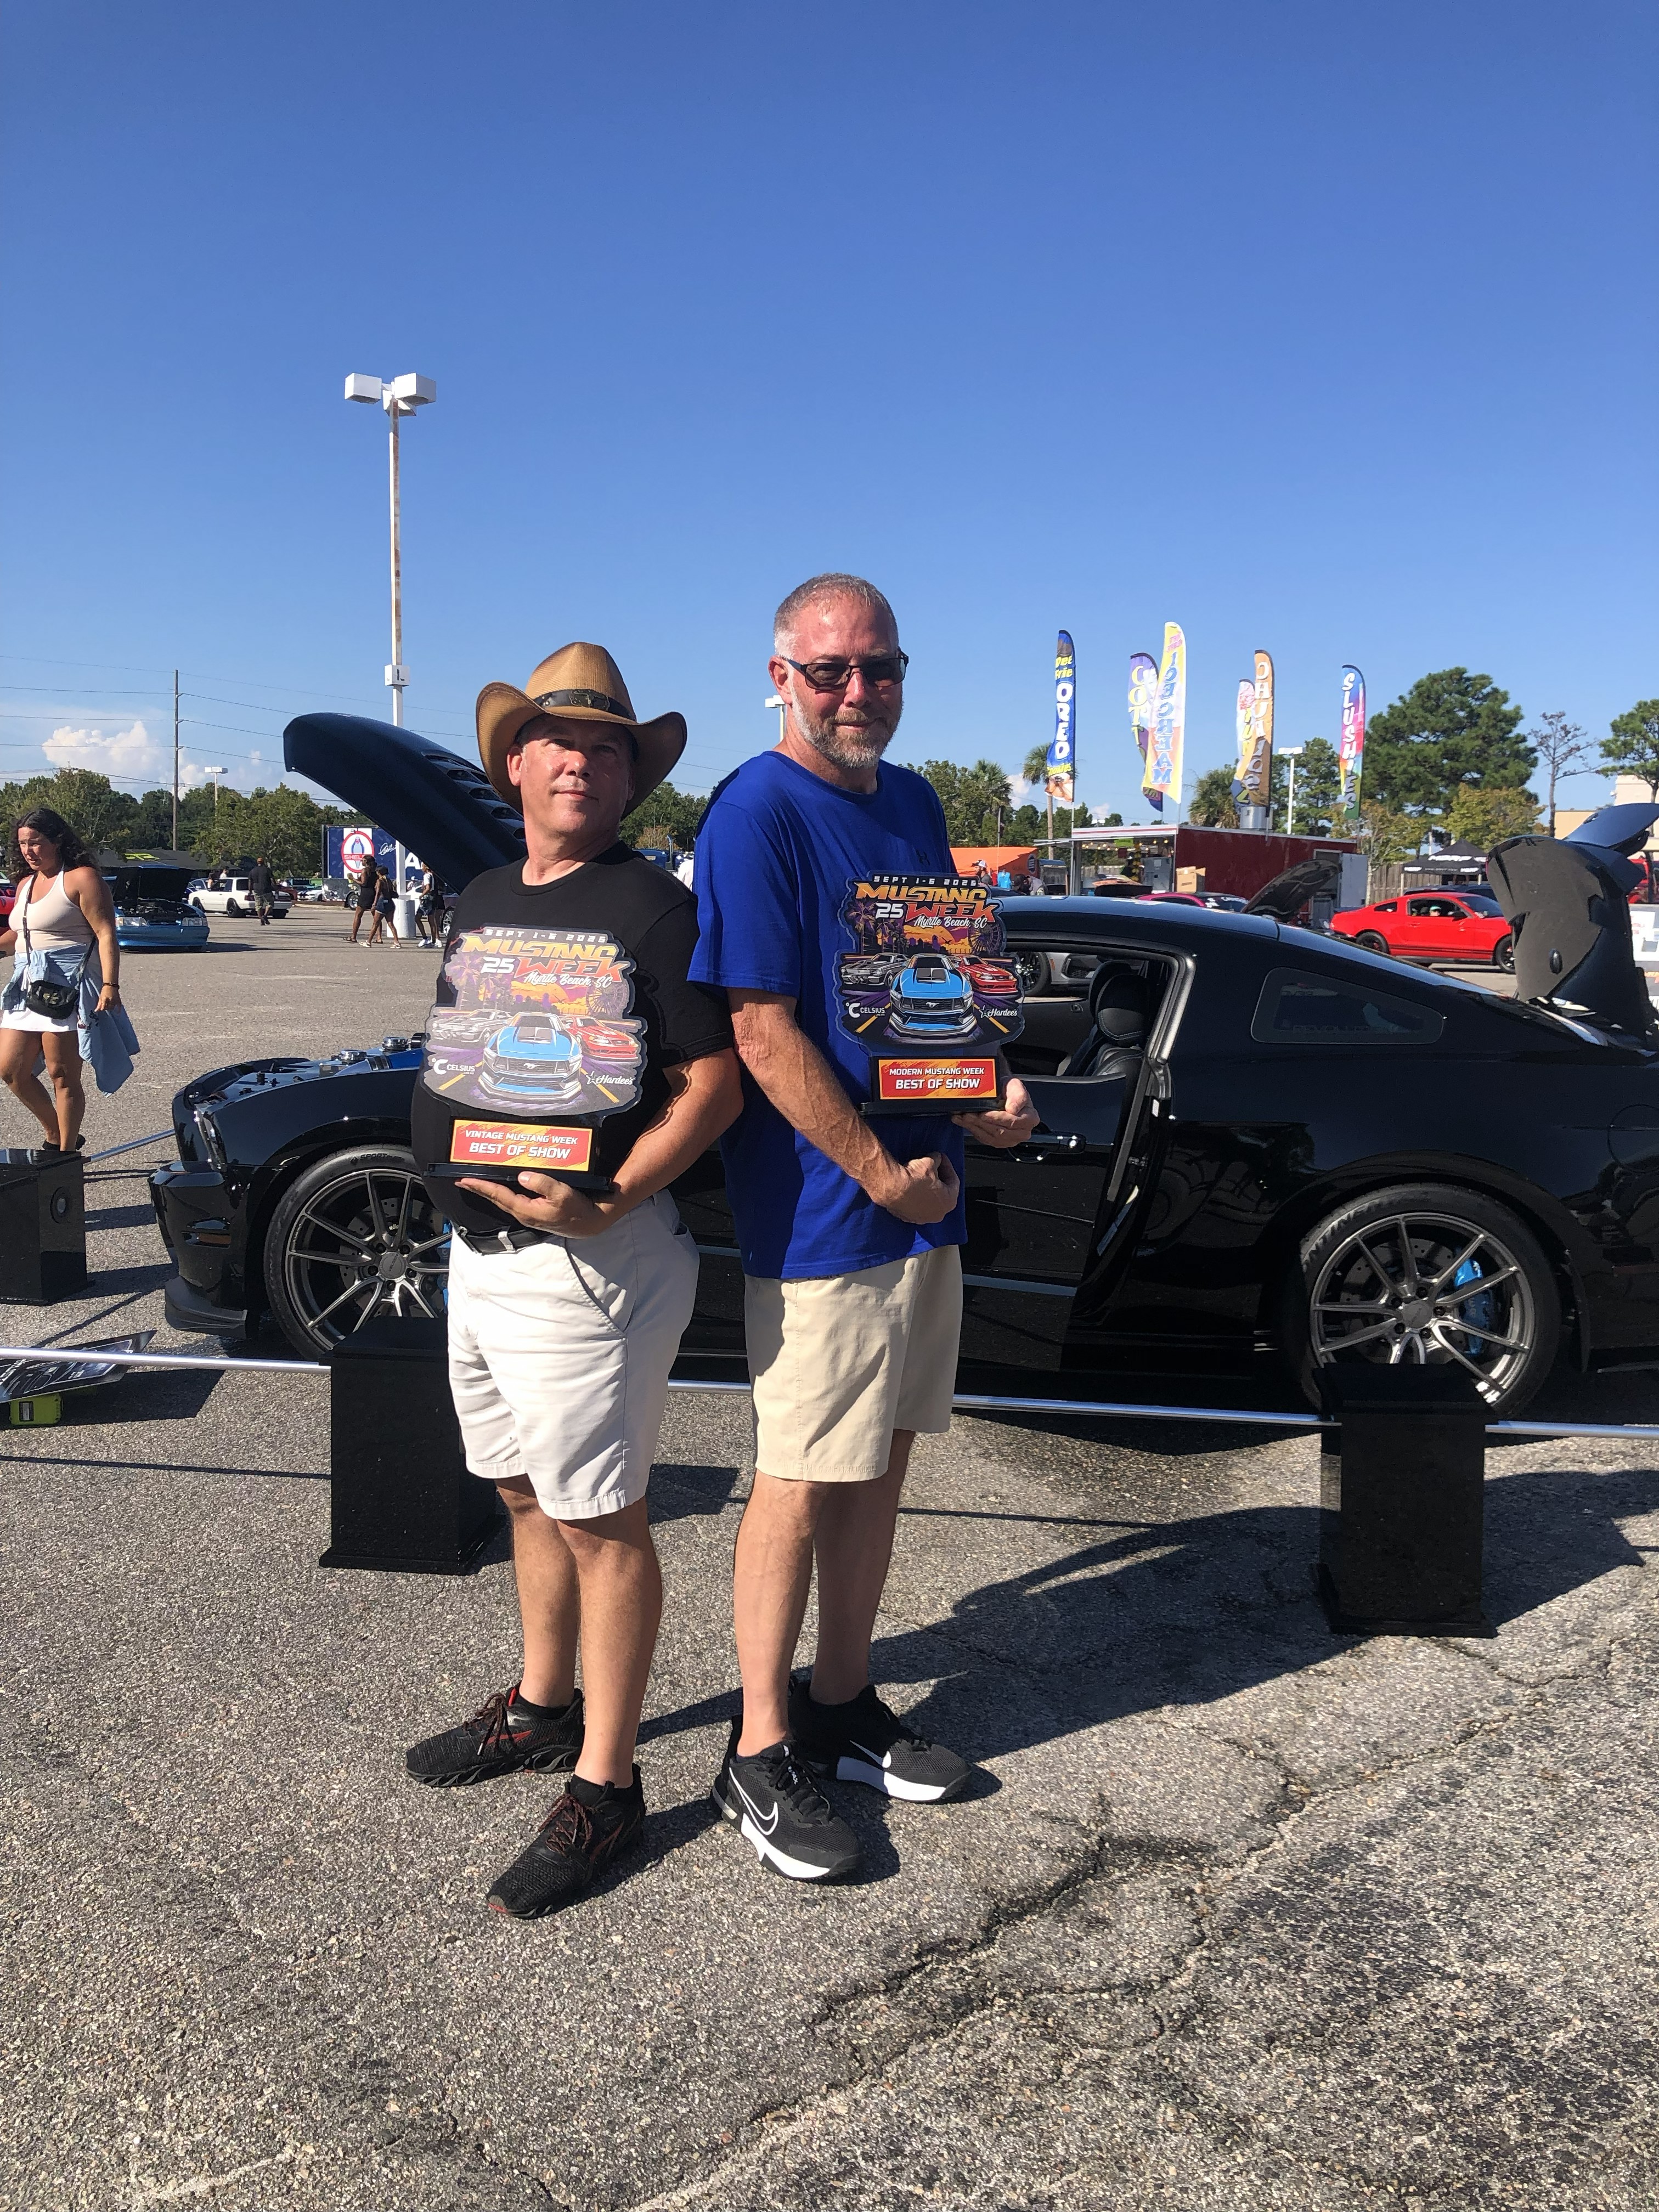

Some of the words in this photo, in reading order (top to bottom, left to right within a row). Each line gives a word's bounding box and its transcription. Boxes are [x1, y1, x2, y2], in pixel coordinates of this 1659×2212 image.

[1054, 682, 1073, 761] OREO
[1341, 673, 1357, 809] SLUSHIES
[854, 882, 987, 902] MUSTANG
[875, 903, 904, 919] 25
[905, 902, 999, 923] WEEK
[913, 916, 942, 928] Myrtle
[974, 917, 988, 929] SC
[485, 929, 525, 938] SEPT
[566, 934, 606, 943] 2025
[461, 935, 617, 960] MUSTANG
[481, 957, 516, 974] 25
[514, 957, 629, 983] WEEK
[523, 972, 558, 986] Myrtle
[595, 976, 613, 989] SC
[988, 1008, 1018, 1017] Hardee's
[447, 1064, 476, 1072] CELSIUS
[889, 1068, 923, 1076] MODERN
[596, 1075, 633, 1085] Hardee's
[895, 1079, 926, 1090] BEST
[927, 1079, 944, 1090] OF
[945, 1079, 980, 1089] SHOW
[465, 1130, 505, 1140] VINTAGE
[506, 1132, 550, 1143] MUSTANG
[552, 1136, 578, 1145] WEEK
[469, 1142, 505, 1154] BEST
[506, 1144, 527, 1156] OF
[527, 1147, 572, 1159] SHOW
